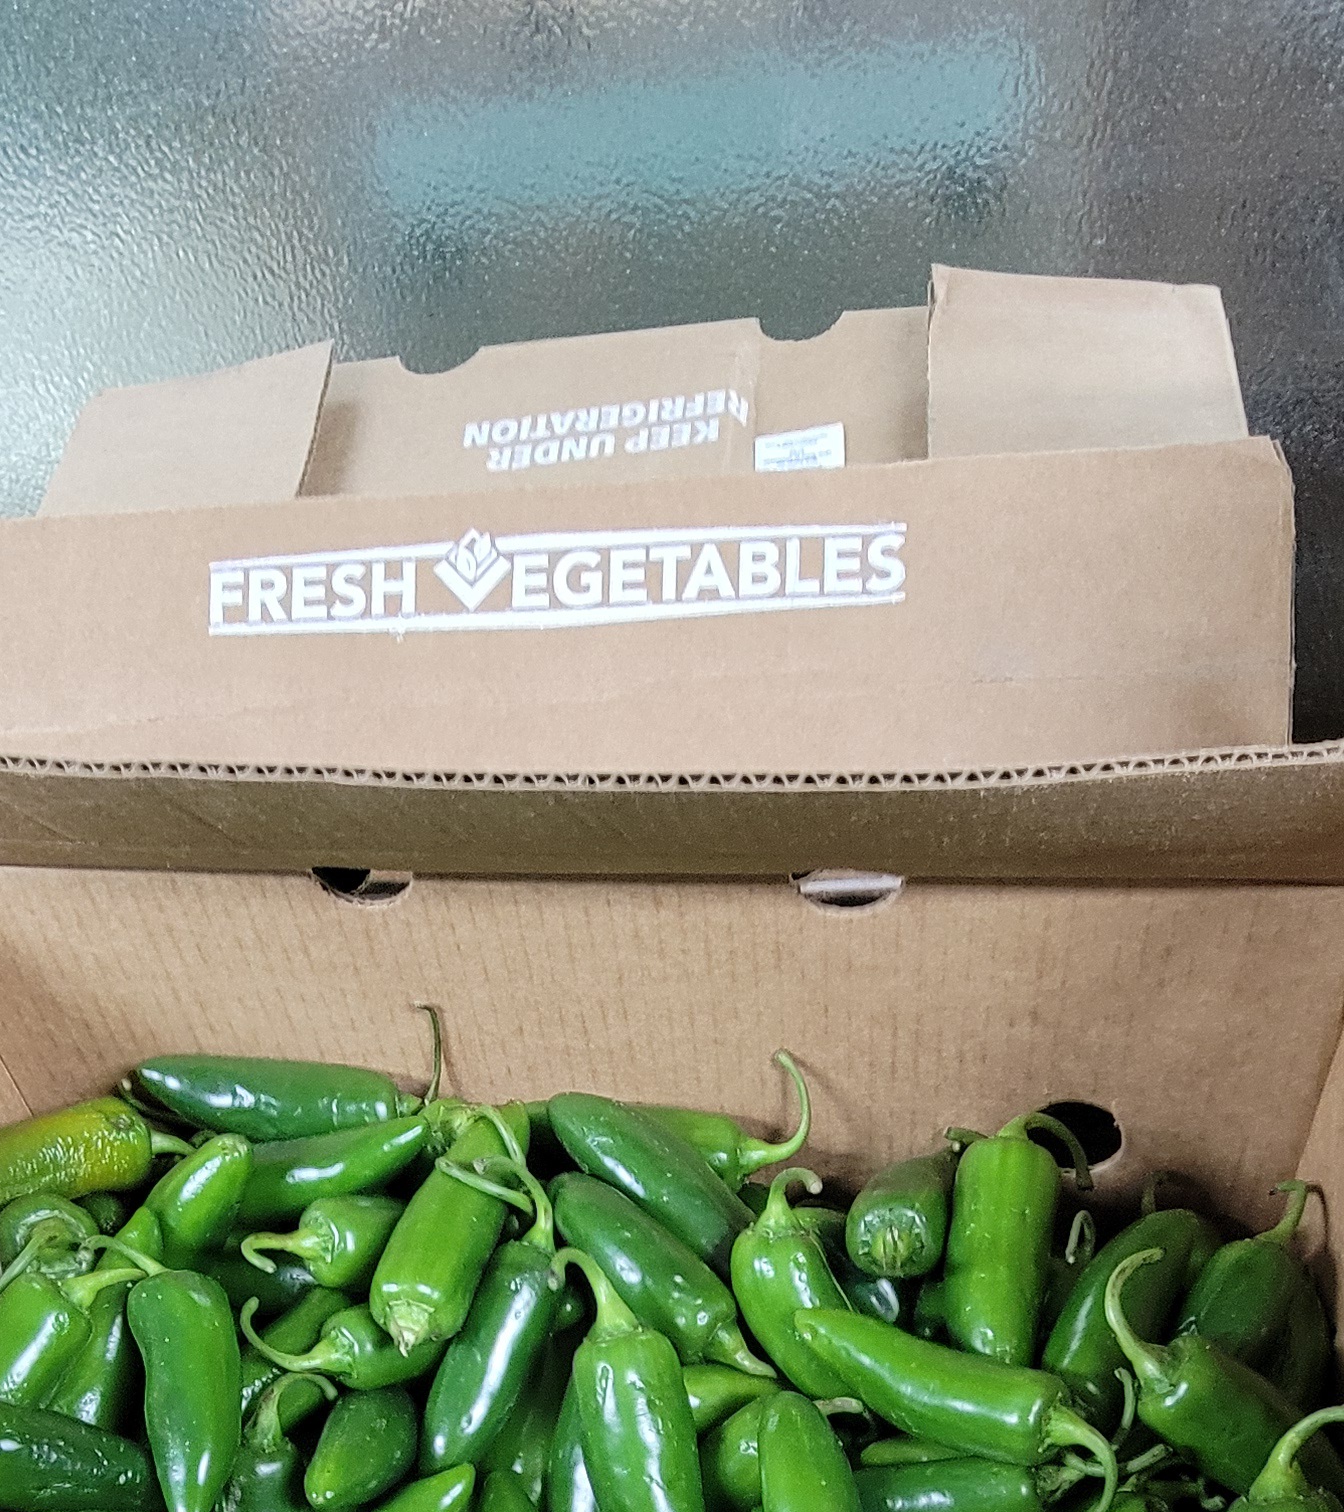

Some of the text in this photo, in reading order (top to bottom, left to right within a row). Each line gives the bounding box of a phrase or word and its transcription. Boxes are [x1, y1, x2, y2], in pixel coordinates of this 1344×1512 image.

[462, 388, 749, 449] REFRIGERATION
[625, 417, 720, 454] KEEP
[485, 432, 617, 473] UNDER
[209, 557, 416, 624] FRESH
